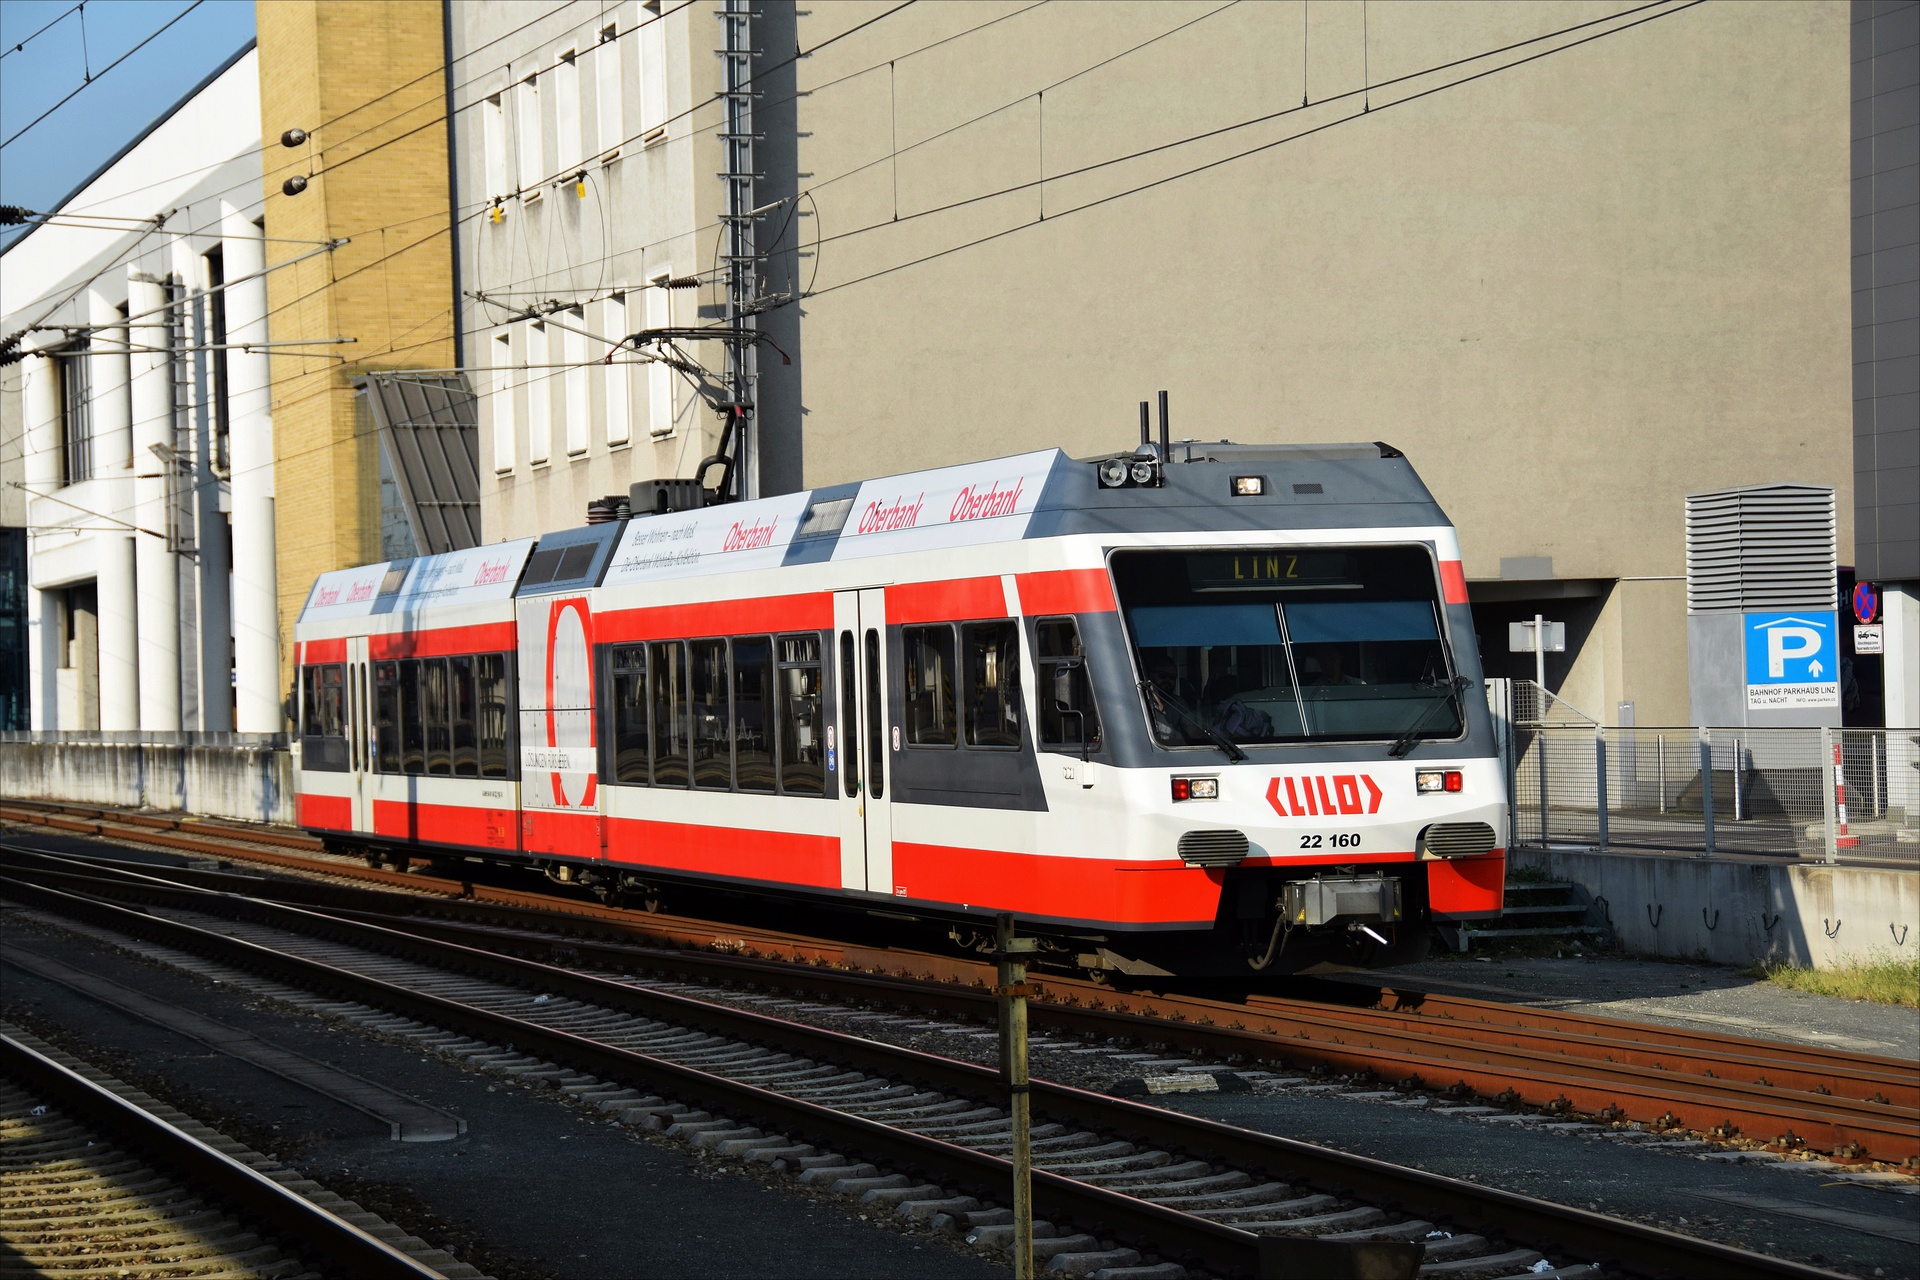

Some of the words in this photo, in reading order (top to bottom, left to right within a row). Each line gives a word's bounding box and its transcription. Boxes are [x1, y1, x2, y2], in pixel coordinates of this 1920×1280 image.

[858, 491, 924, 534] Oberbank
[949, 477, 1024, 523] Oberbank
[723, 514, 779, 552] Oberbank
[474, 556, 511, 586] Oberbank
[1234, 555, 1298, 579] LINZ
[314, 581, 343, 607] Oberbank
[346, 577, 376, 603] Oberbank
[1767, 626, 1822, 678] P
[1749, 688, 1782, 697] BAHNHOF
[1783, 686, 1820, 695] PARKHAUS
[1820, 686, 1836, 694] LINZ
[1299, 834, 1323, 849] 22
[1328, 833, 1361, 848] 160
